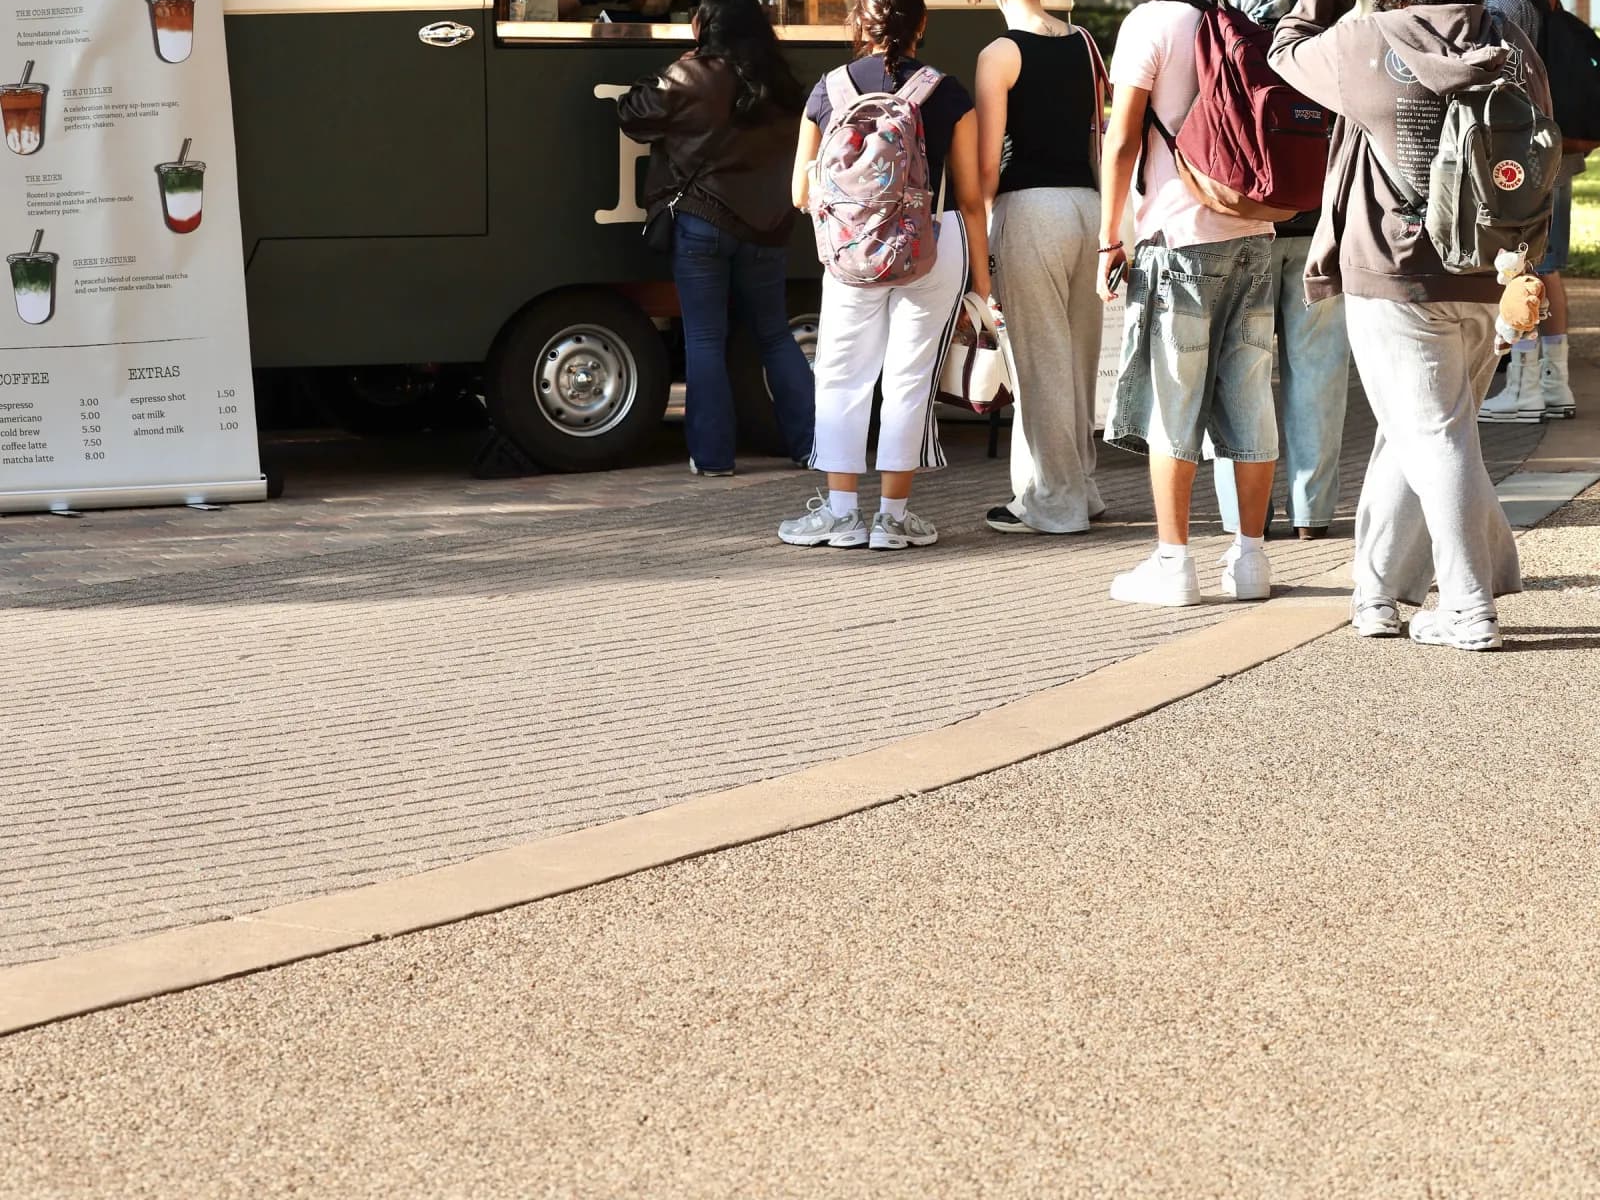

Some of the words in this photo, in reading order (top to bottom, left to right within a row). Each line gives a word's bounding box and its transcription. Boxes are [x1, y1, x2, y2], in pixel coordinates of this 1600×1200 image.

[16, 9, 31, 17] THE
[25, 175, 40, 183] THE
[73, 257, 98, 266] GREEN
[100, 255, 136, 265] PASTURES
[127, 365, 180, 380] EXTRAS
[79, 398, 99, 407] 3.00
[130, 394, 166, 405] espresso
[168, 393, 186, 401] shot
[217, 389, 235, 398] 1.50
[0, 415, 42, 423] americano
[80, 411, 101, 420] 5.00
[131, 412, 145, 420] oat
[147, 409, 166, 419] milk
[219, 405, 237, 414] 1.00
[0, 428, 17, 437] cold
[20, 428, 40, 437] brew
[82, 425, 101, 434] 5.50
[133, 426, 164, 436] almond
[166, 425, 184, 434] milk
[220, 421, 239, 430] 1.00
[1, 441, 27, 450] coffee
[28, 441, 48, 450] latte
[83, 438, 102, 447] 7.50
[2, 456, 34, 464] matcha
[35, 454, 54, 463] latte
[85, 451, 105, 460] 8.00
